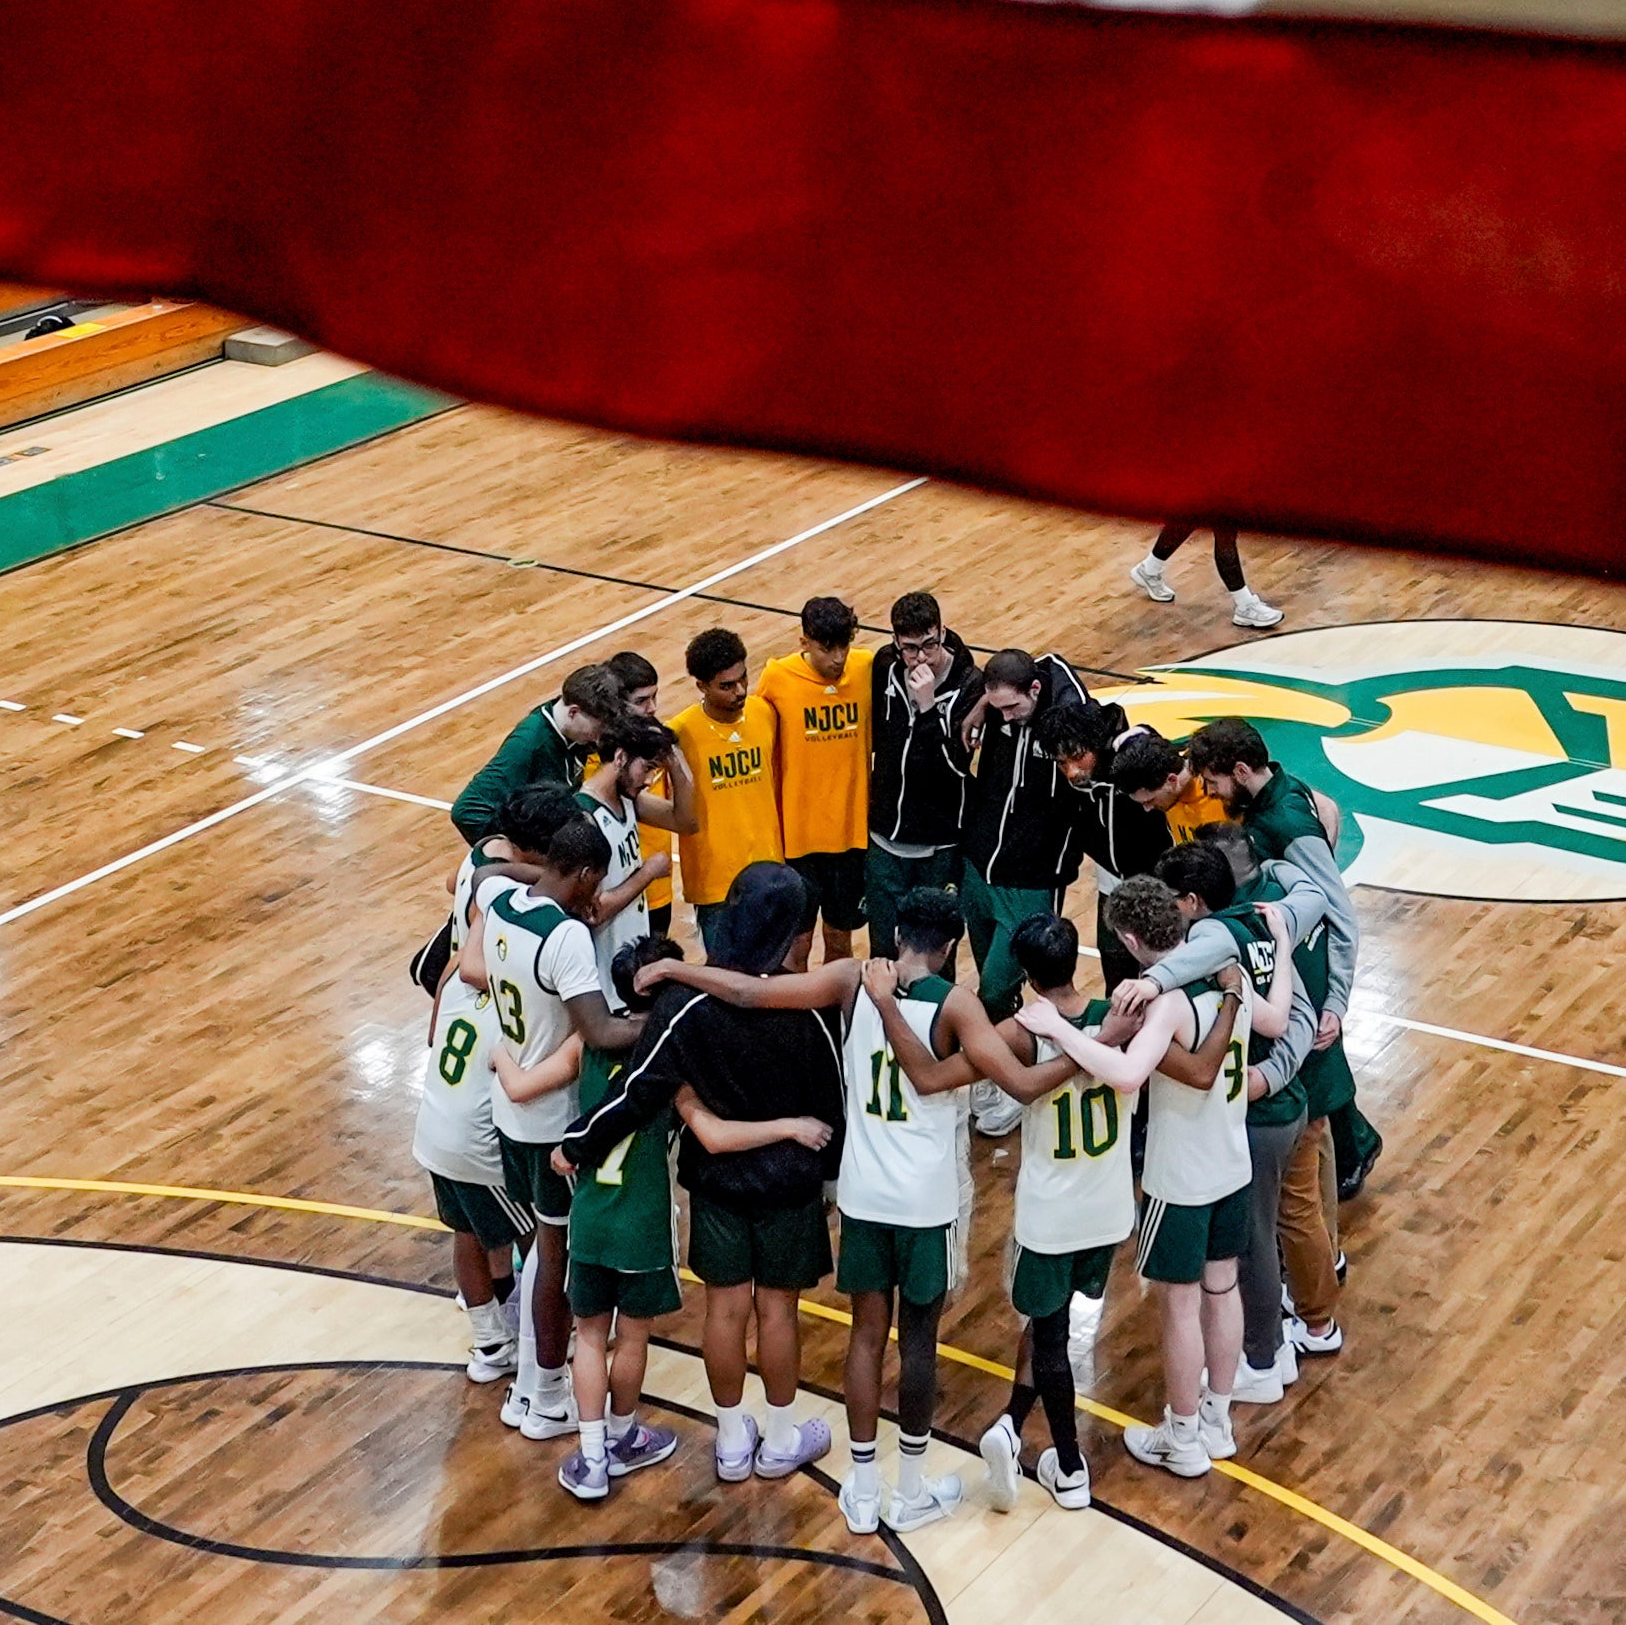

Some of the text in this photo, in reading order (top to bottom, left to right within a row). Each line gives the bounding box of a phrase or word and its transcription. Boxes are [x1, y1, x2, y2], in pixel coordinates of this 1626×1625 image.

[804, 703, 858, 732] NJCU
[709, 747, 761, 778] NJCU
[438, 1017, 478, 1087] 8
[866, 1049, 908, 1122] 11
[1052, 1082, 1119, 1160] 10
